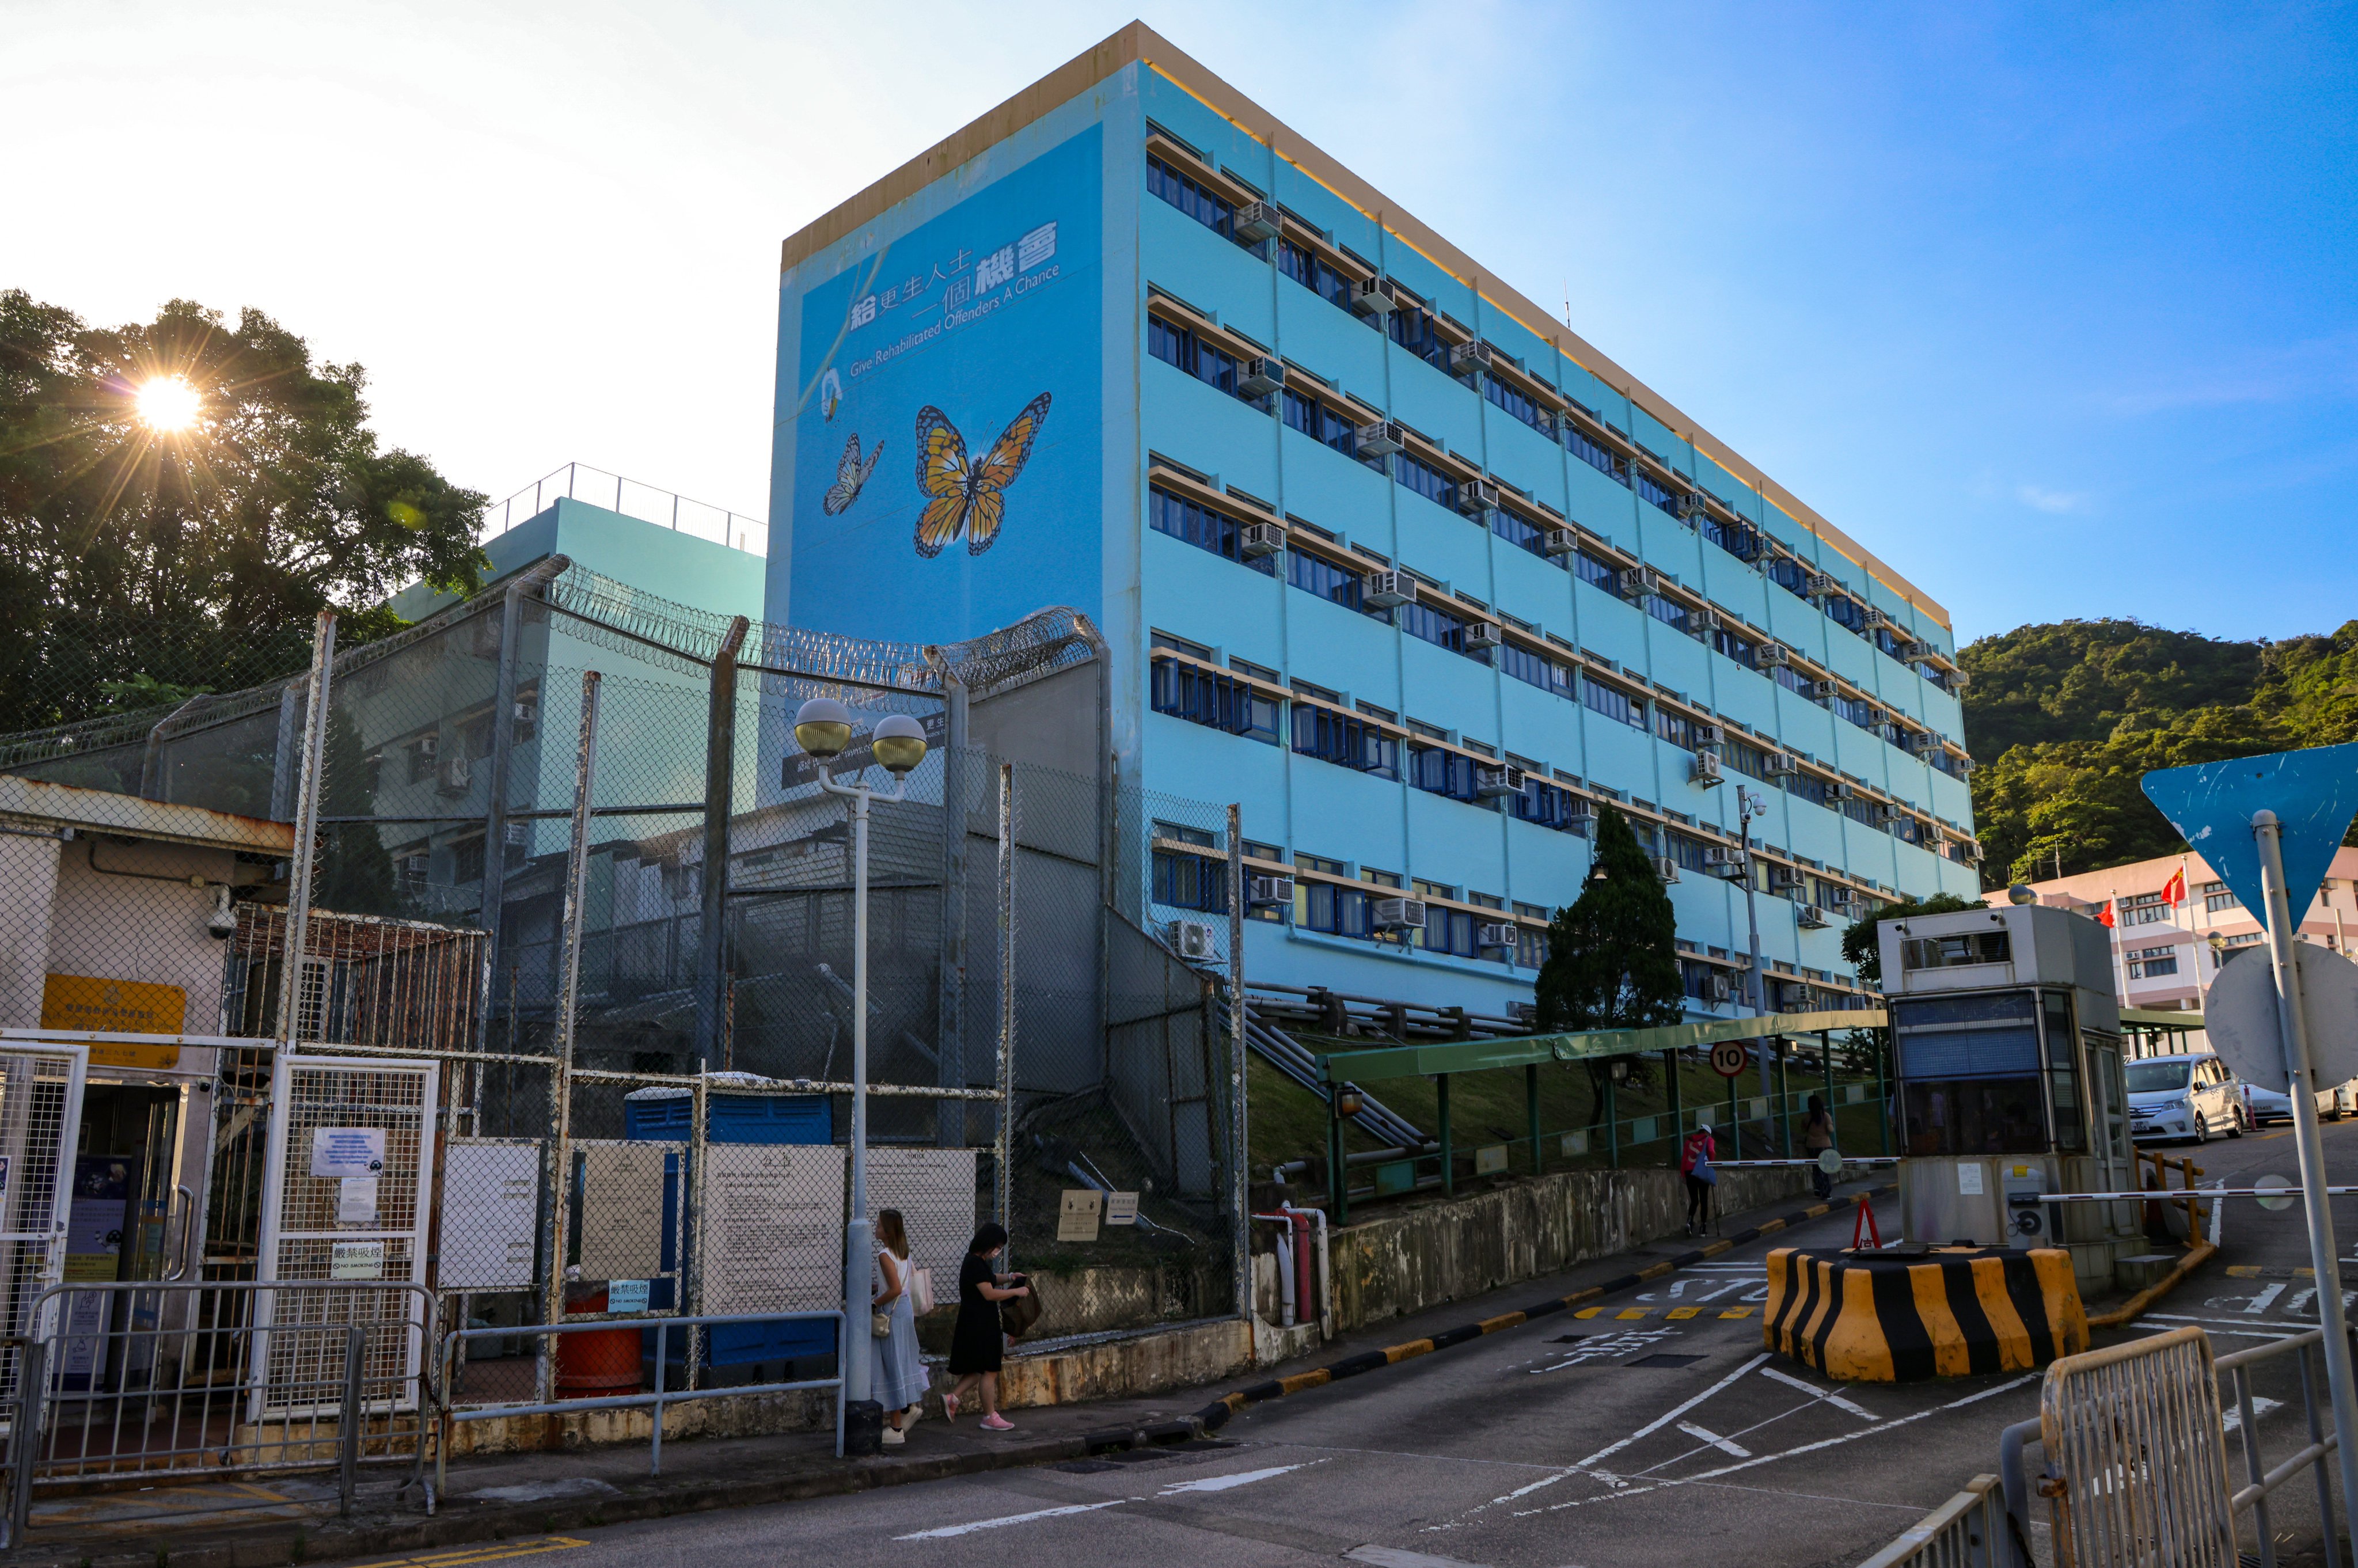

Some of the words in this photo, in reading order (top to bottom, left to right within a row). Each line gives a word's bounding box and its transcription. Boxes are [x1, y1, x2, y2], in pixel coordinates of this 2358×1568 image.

[850, 358, 872, 378] Give
[875, 321, 941, 366] Rehabilitated
[944, 297, 1000, 331] Offenders
[1003, 288, 1013, 303] A
[1015, 264, 1060, 294] Chance
[1717, 1050, 1740, 1067] 10
[333, 1247, 382, 1259] 嚴禁吸煙
[610, 1284, 648, 1294] 嚴禁吸煙
